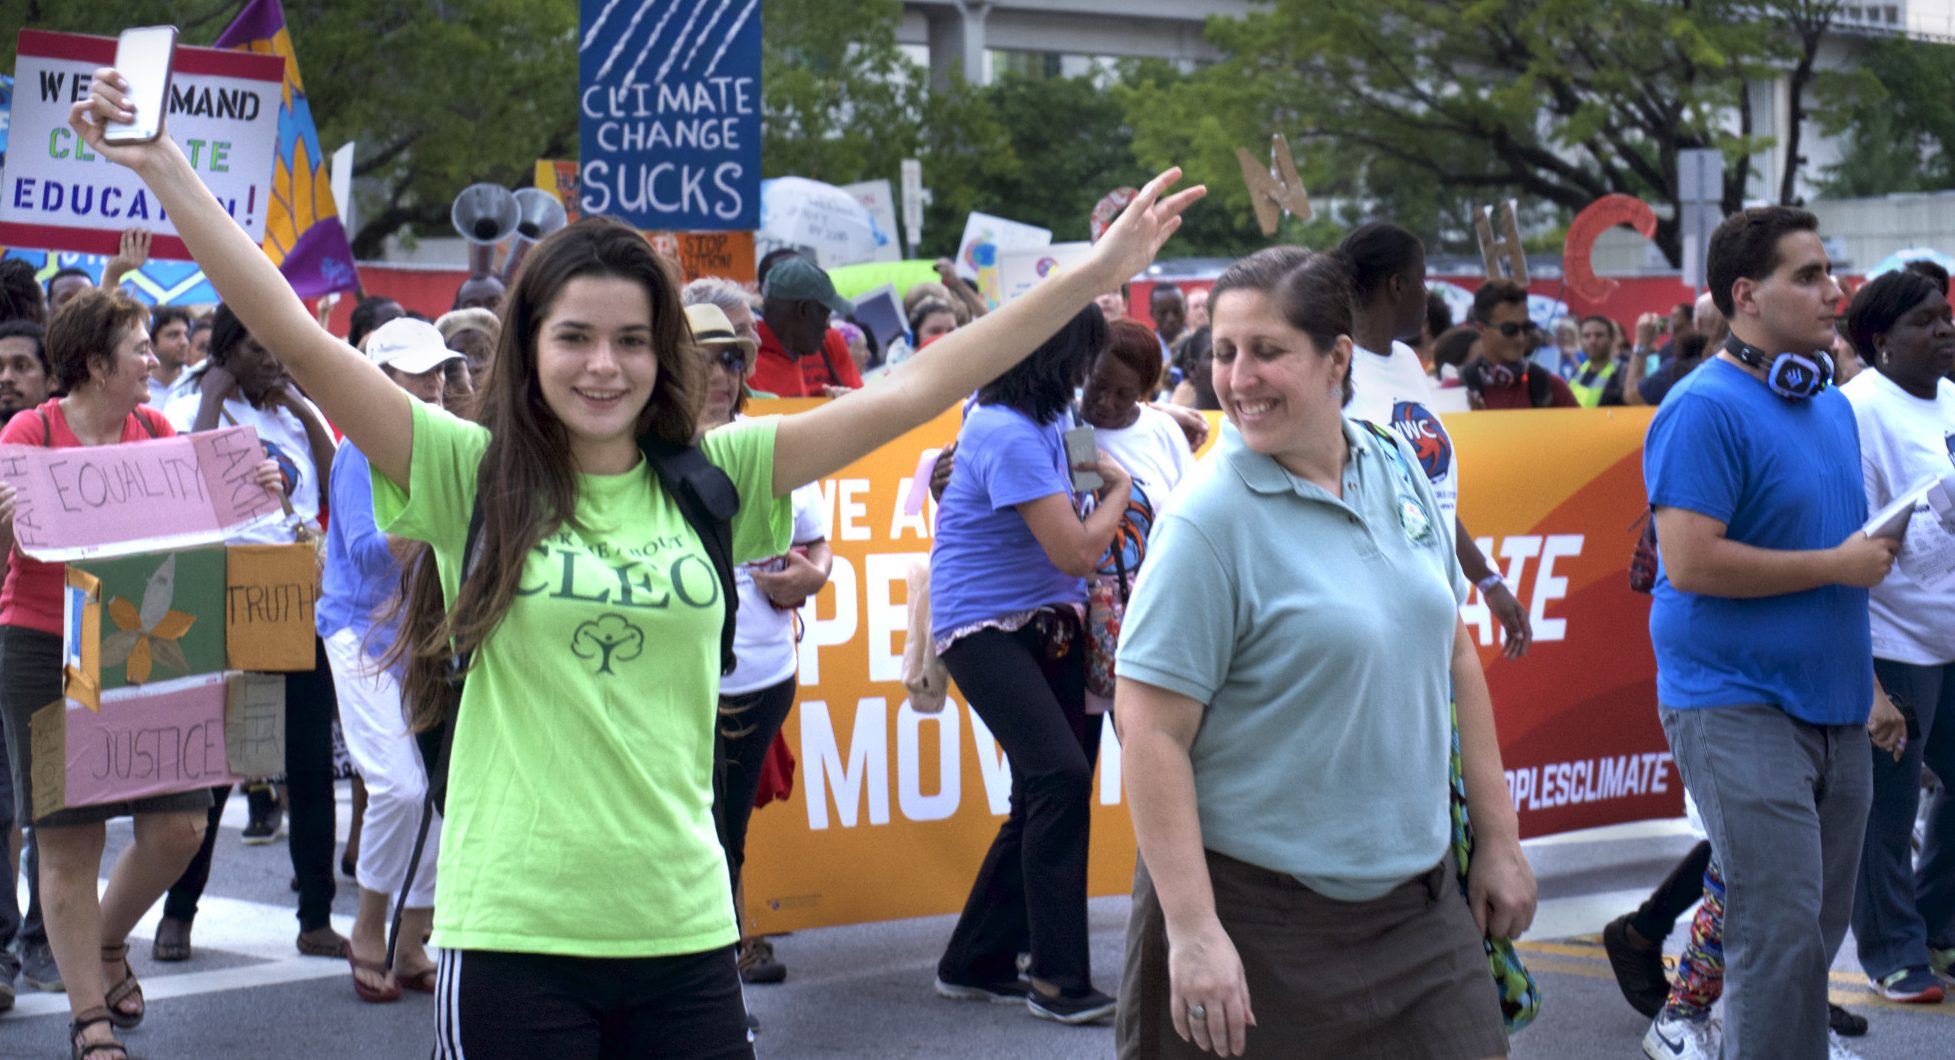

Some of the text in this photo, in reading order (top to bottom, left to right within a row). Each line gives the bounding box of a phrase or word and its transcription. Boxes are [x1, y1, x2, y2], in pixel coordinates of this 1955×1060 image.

[39, 70, 260, 121] WE MAND
[582, 77, 753, 119] CLIMATE
[49, 127, 232, 172] CLTE
[597, 117, 741, 151] CHANGE
[13, 177, 256, 227] EDUCA!
[580, 160, 743, 219] SUCKS
[49, 455, 205, 513] EQUALITY
[228, 583, 315, 625] TRUTH
[1458, 534, 1585, 646] ATE
[92, 719, 223, 781] JUSTICE
